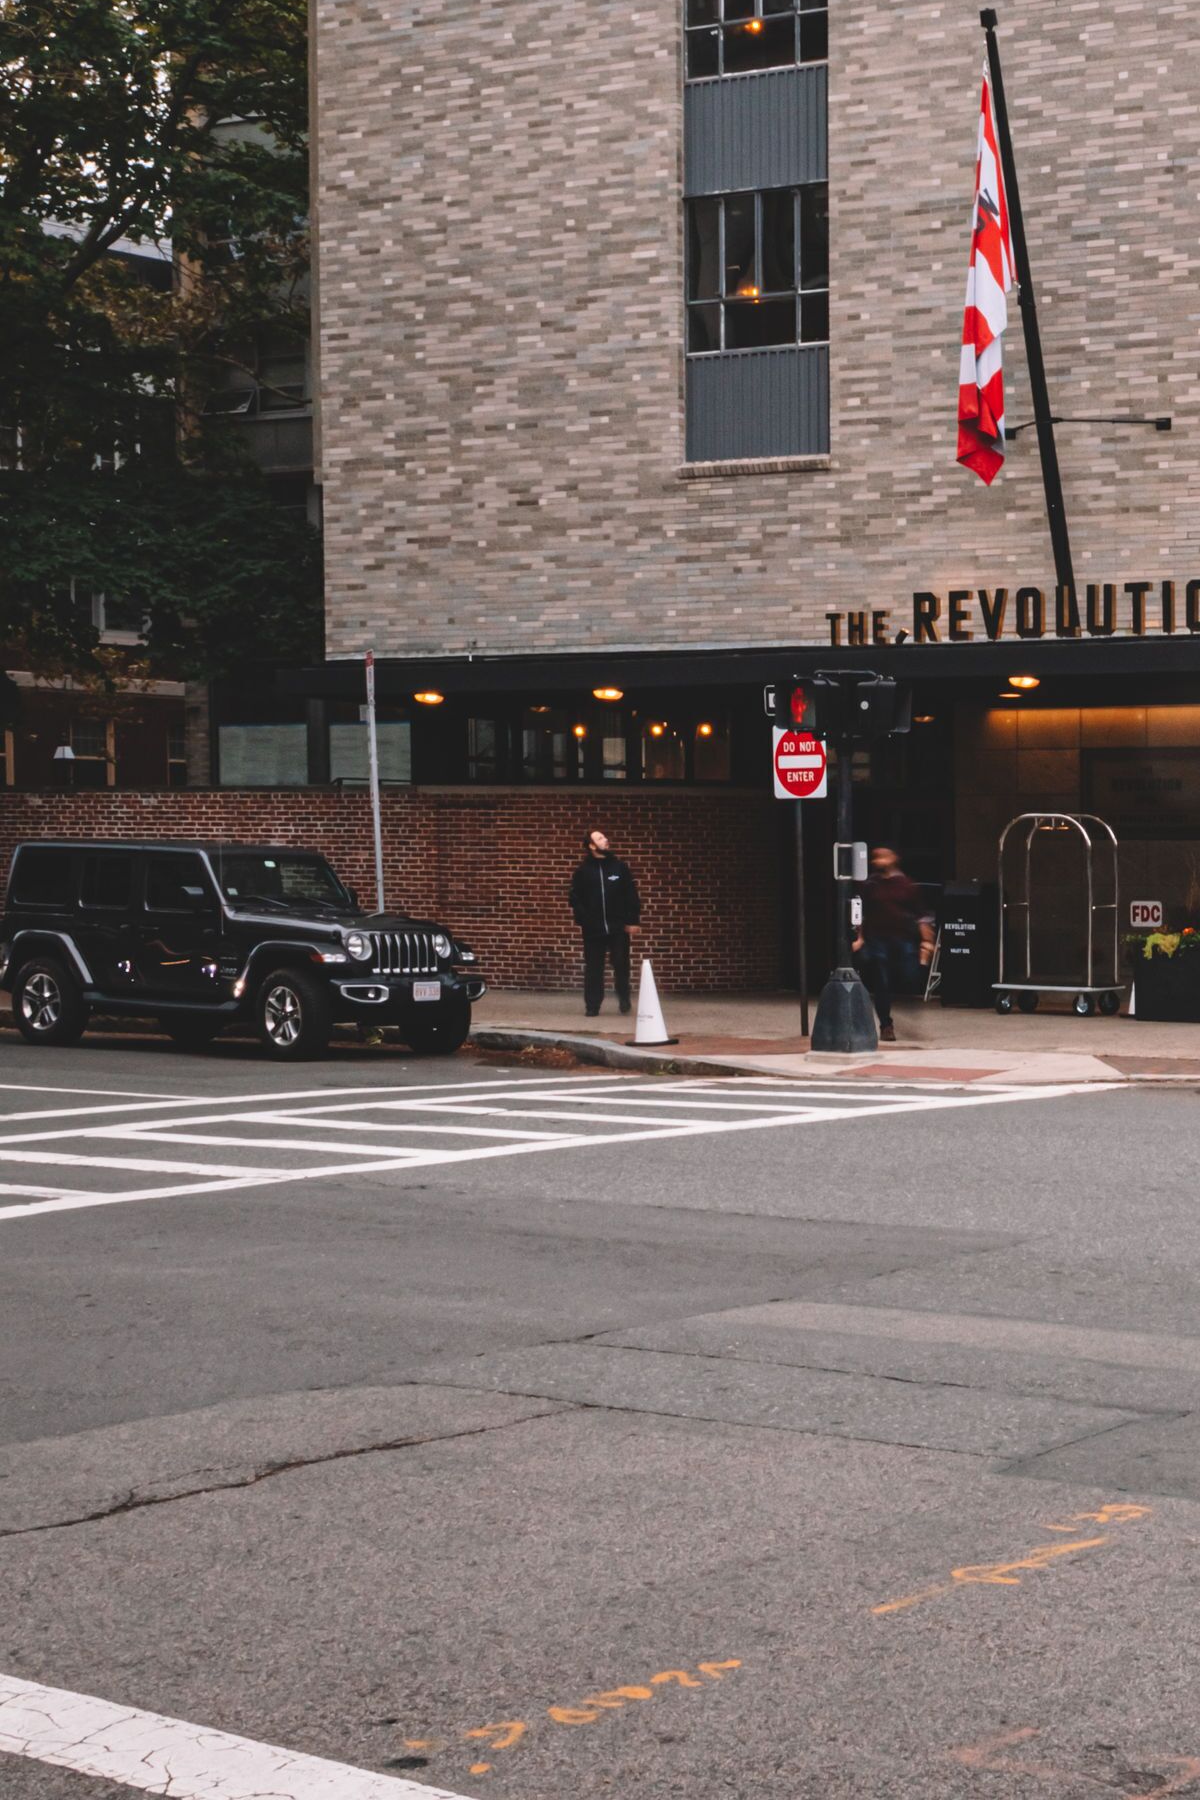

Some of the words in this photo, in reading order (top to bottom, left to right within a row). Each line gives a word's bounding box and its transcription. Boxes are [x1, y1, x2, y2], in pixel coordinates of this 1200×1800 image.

[825, 611, 891, 646] THE
[783, 742, 796, 753] DO
[799, 741, 816, 752] NOT
[787, 771, 815, 782] ENTER
[1132, 905, 1161, 922] FDC
